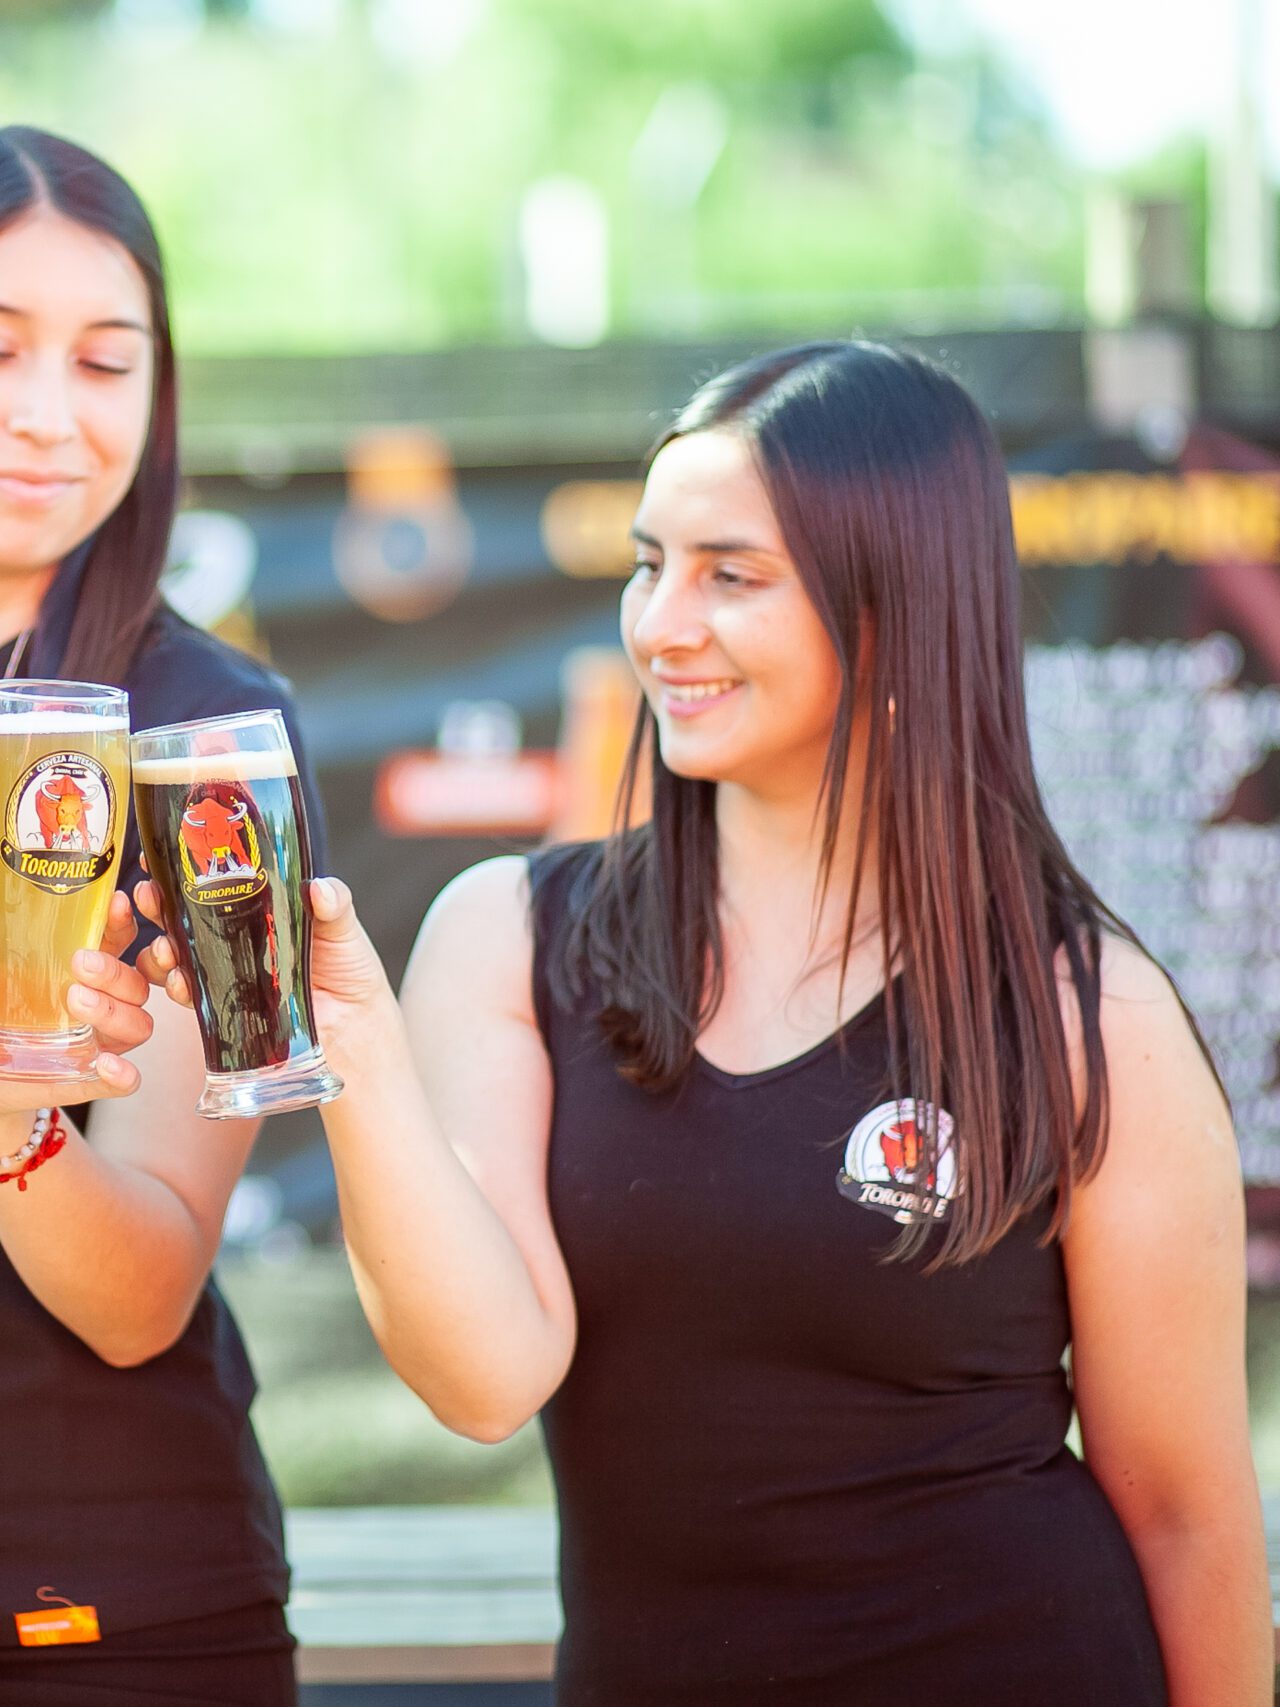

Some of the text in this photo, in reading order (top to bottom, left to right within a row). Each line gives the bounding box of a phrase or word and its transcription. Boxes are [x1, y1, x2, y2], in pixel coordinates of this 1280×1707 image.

[36, 755, 66, 772] CERVEZA
[21, 853, 99, 879] TOROPAIRE
[198, 882, 254, 901] TOROPAIRE
